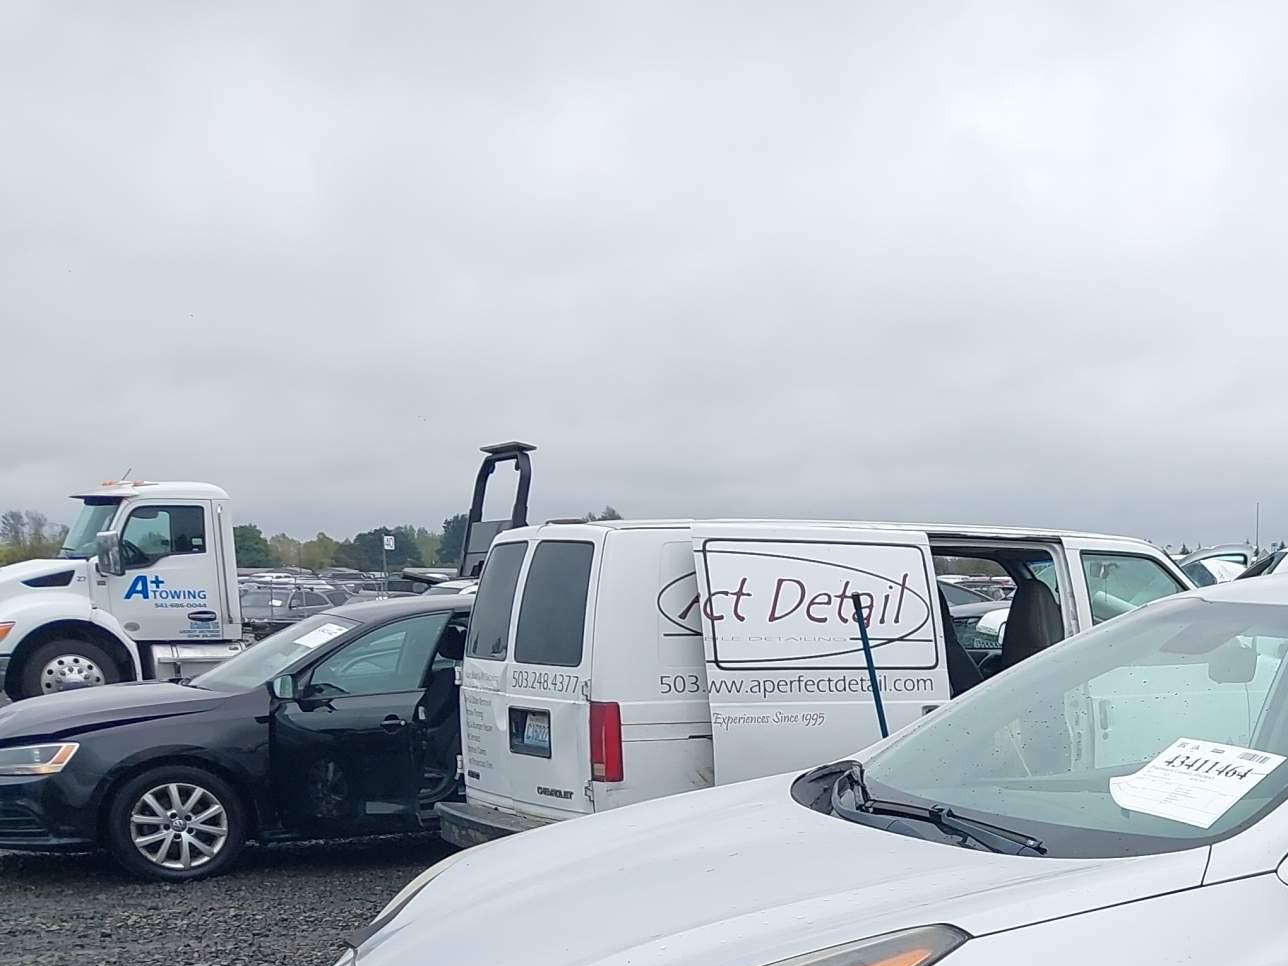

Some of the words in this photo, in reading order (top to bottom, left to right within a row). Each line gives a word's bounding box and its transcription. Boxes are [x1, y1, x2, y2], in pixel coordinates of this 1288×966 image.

[123, 574, 165, 600] A+
[150, 589, 207, 600] TOWING
[768, 573, 909, 628] Detail
[511, 670, 580, 694] 503.248.4377
[713, 712, 770, 731] Experiences
[772, 711, 799, 724] Since
[801, 711, 825, 727] 1995
[1164, 754, 1254, 780] 43411464
